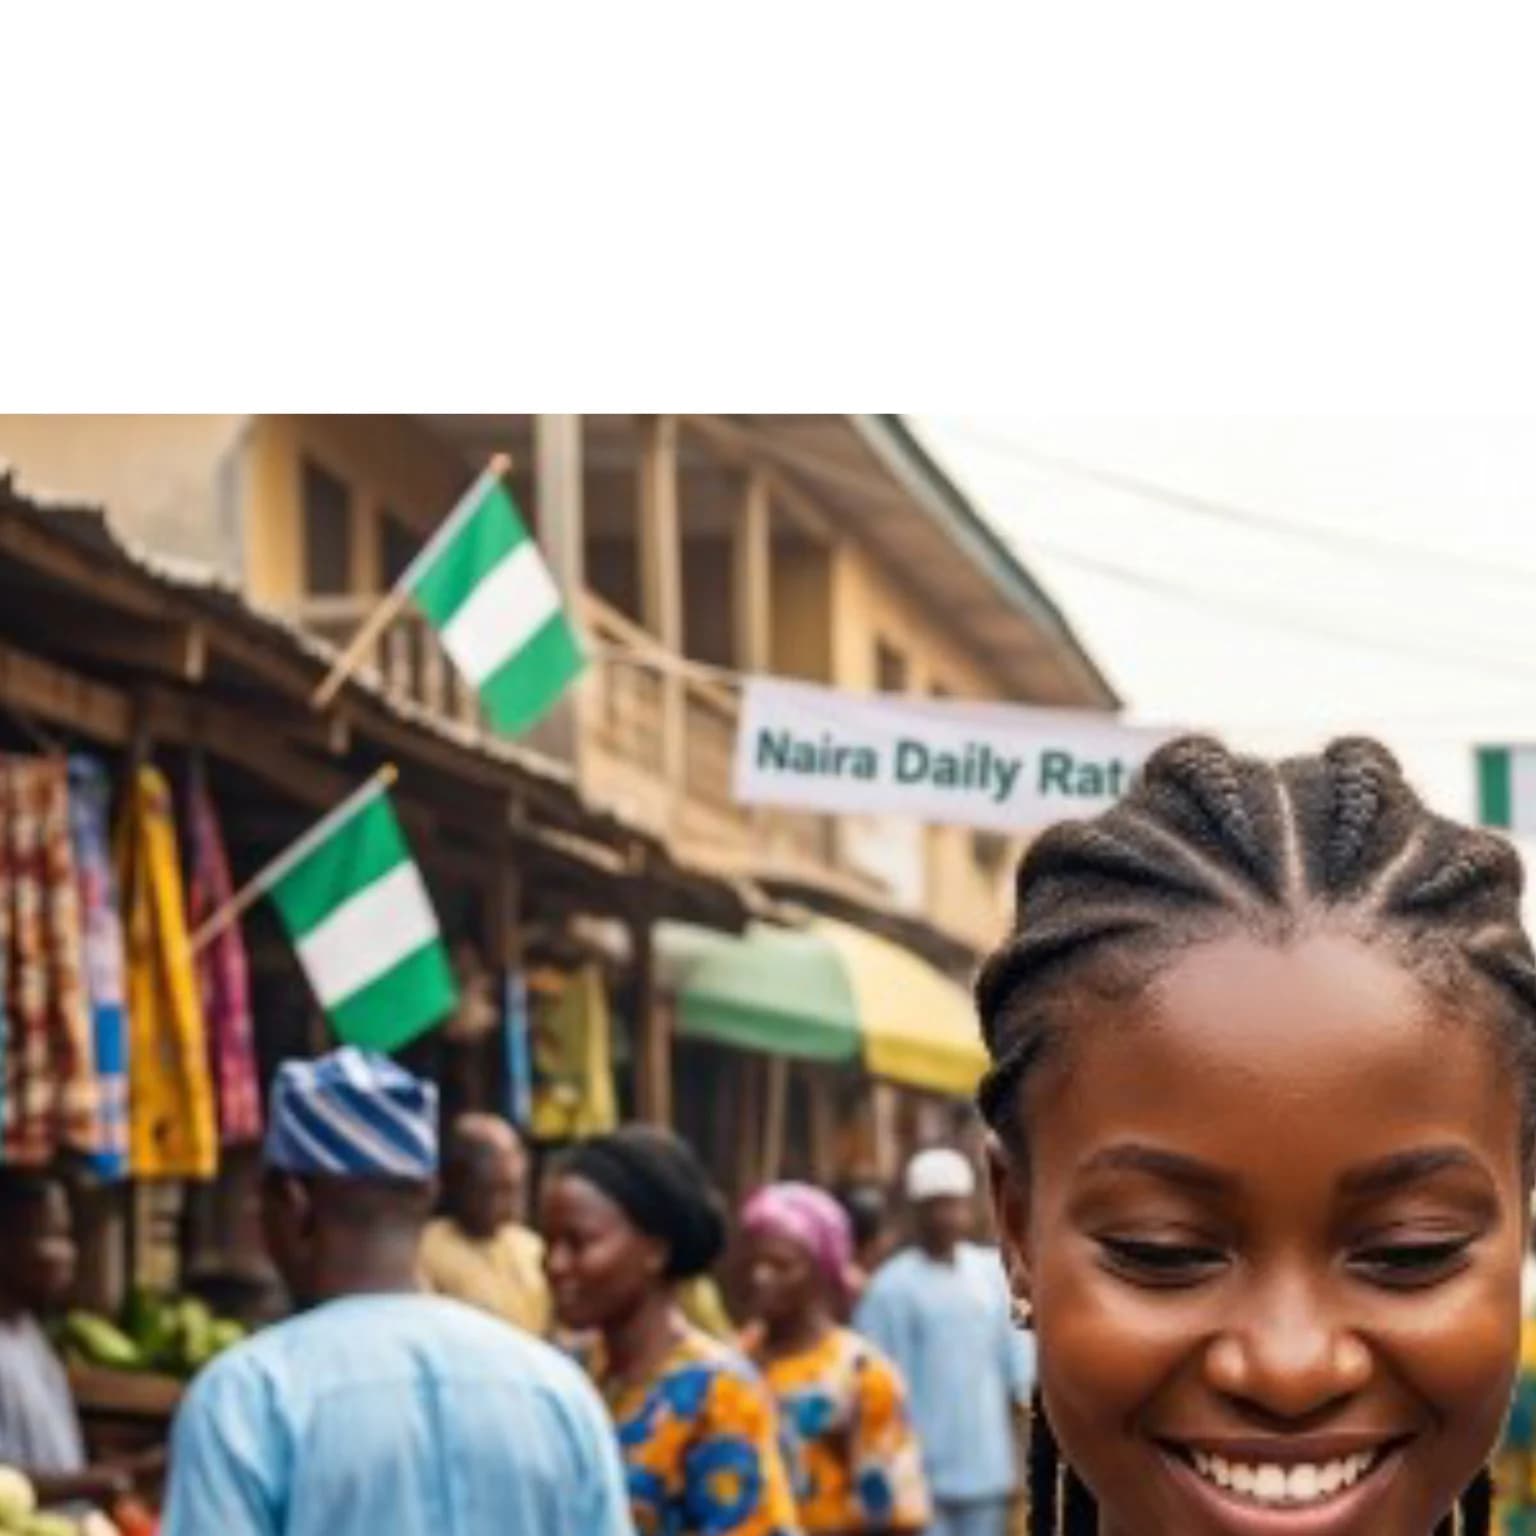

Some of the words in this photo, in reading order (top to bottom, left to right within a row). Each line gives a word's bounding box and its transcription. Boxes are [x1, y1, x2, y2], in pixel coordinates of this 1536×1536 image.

[757, 728, 878, 782] Naira
[895, 738, 1022, 804] Daily
[1040, 752, 1137, 800] Rat
